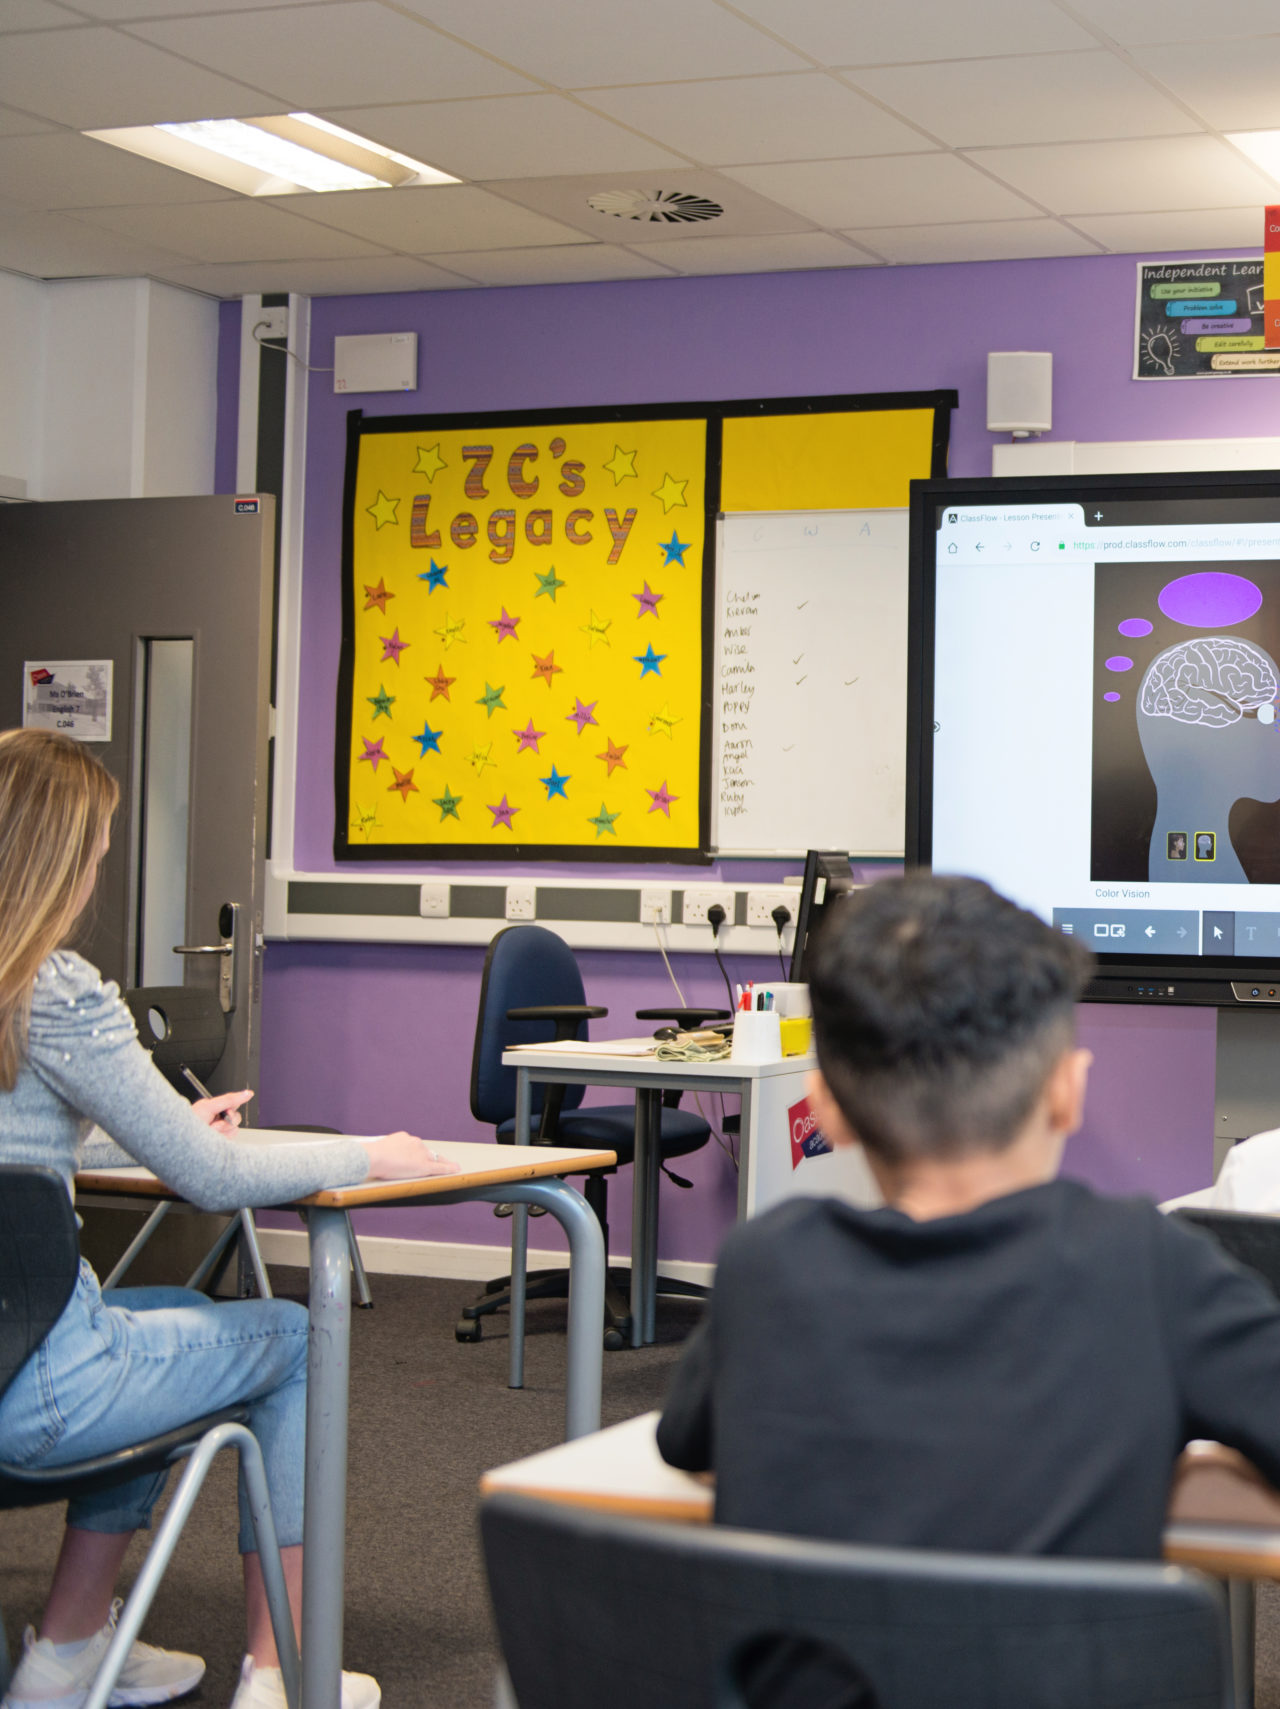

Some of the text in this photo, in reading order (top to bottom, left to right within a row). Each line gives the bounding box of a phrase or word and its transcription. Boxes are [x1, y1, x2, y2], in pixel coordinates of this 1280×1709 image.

[1143, 264, 1264, 282] Independent Lear
[1214, 340, 1254, 348] Edit carefully
[1218, 357, 1280, 366] Extend work further
[461, 437, 586, 500] 7 C's
[960, 513, 998, 523] ClassFlow
[1003, 512, 1030, 522] Lesson
[410, 494, 638, 564] Legacy
[859, 522, 871, 537] A
[721, 680, 755, 698] Harley
[720, 791, 745, 806] Ruby
[1095, 888, 1150, 899] Color Vision
